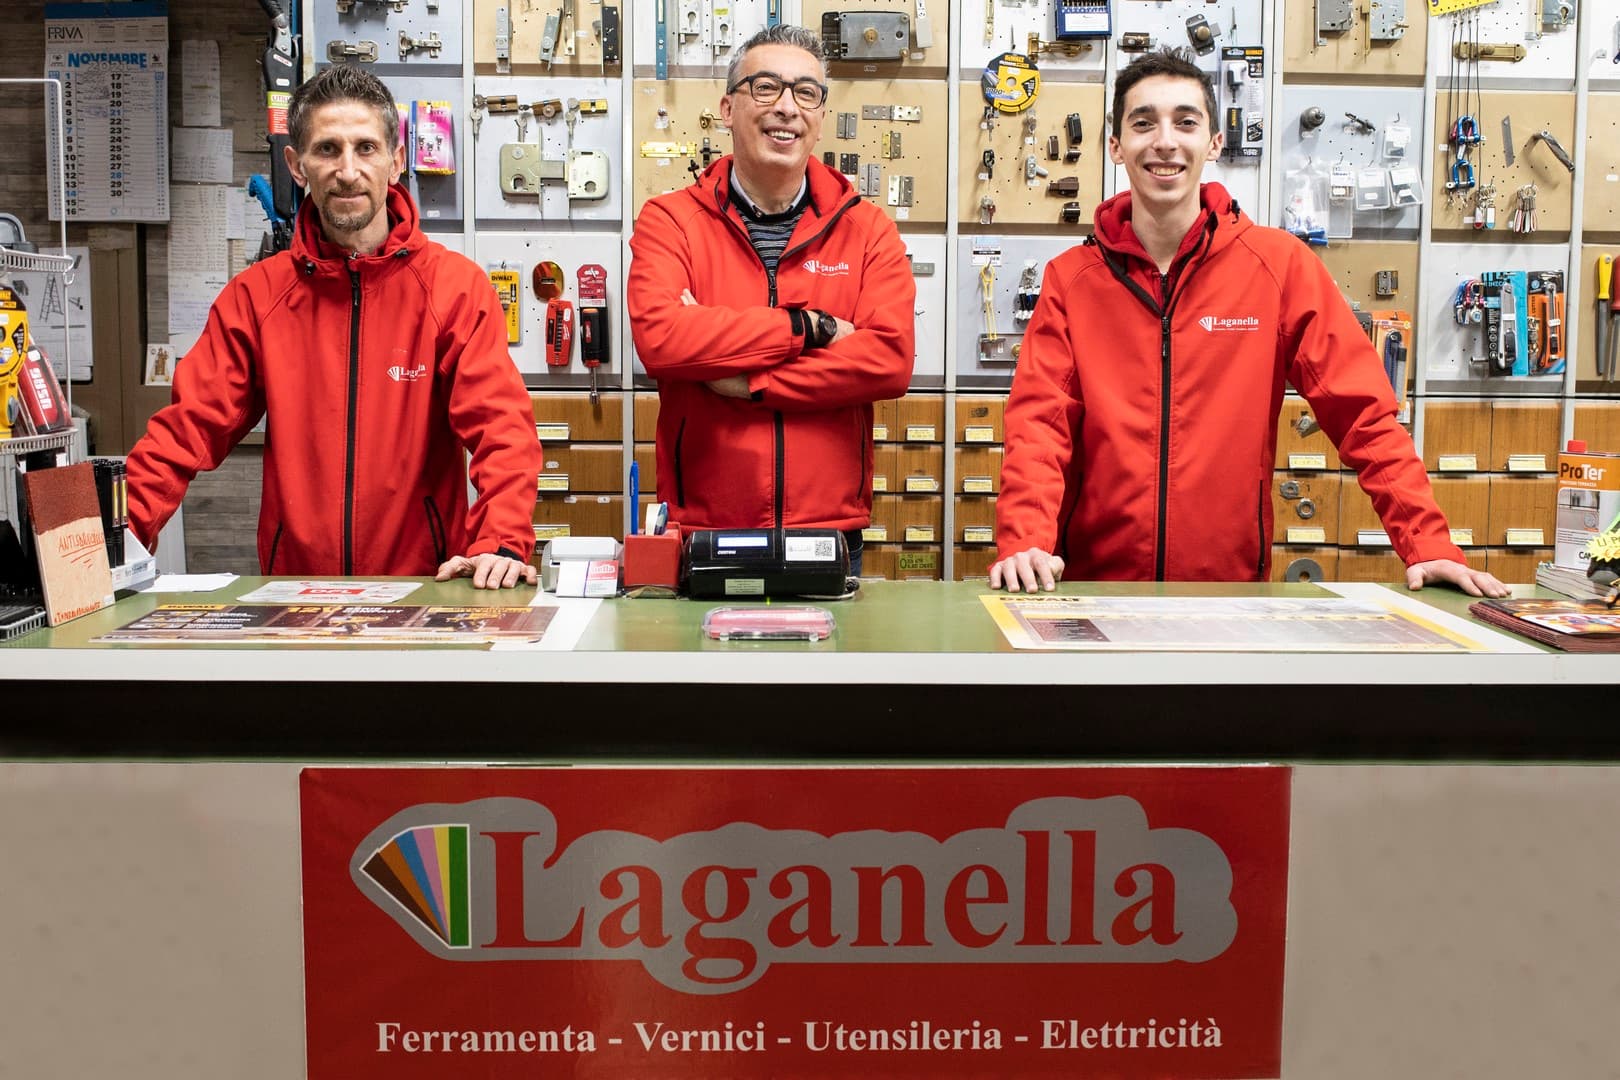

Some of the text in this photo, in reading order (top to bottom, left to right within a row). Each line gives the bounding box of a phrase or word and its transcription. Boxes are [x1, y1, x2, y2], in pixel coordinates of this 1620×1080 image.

[48, 26, 83, 40] FRIVA
[67, 53, 147, 68] NOVEMBRE
[1213, 316, 1259, 328] Laganella
[29, 367, 53, 409] USAG
[1560, 462, 1604, 481] ProTer
[480, 830, 1184, 984] Laganella
[376, 1022, 597, 1053] Ferramenta
[633, 1022, 767, 1052] Vernici
[803, 1020, 1002, 1051] Utensileria
[1039, 1017, 1223, 1049] Elettricità
